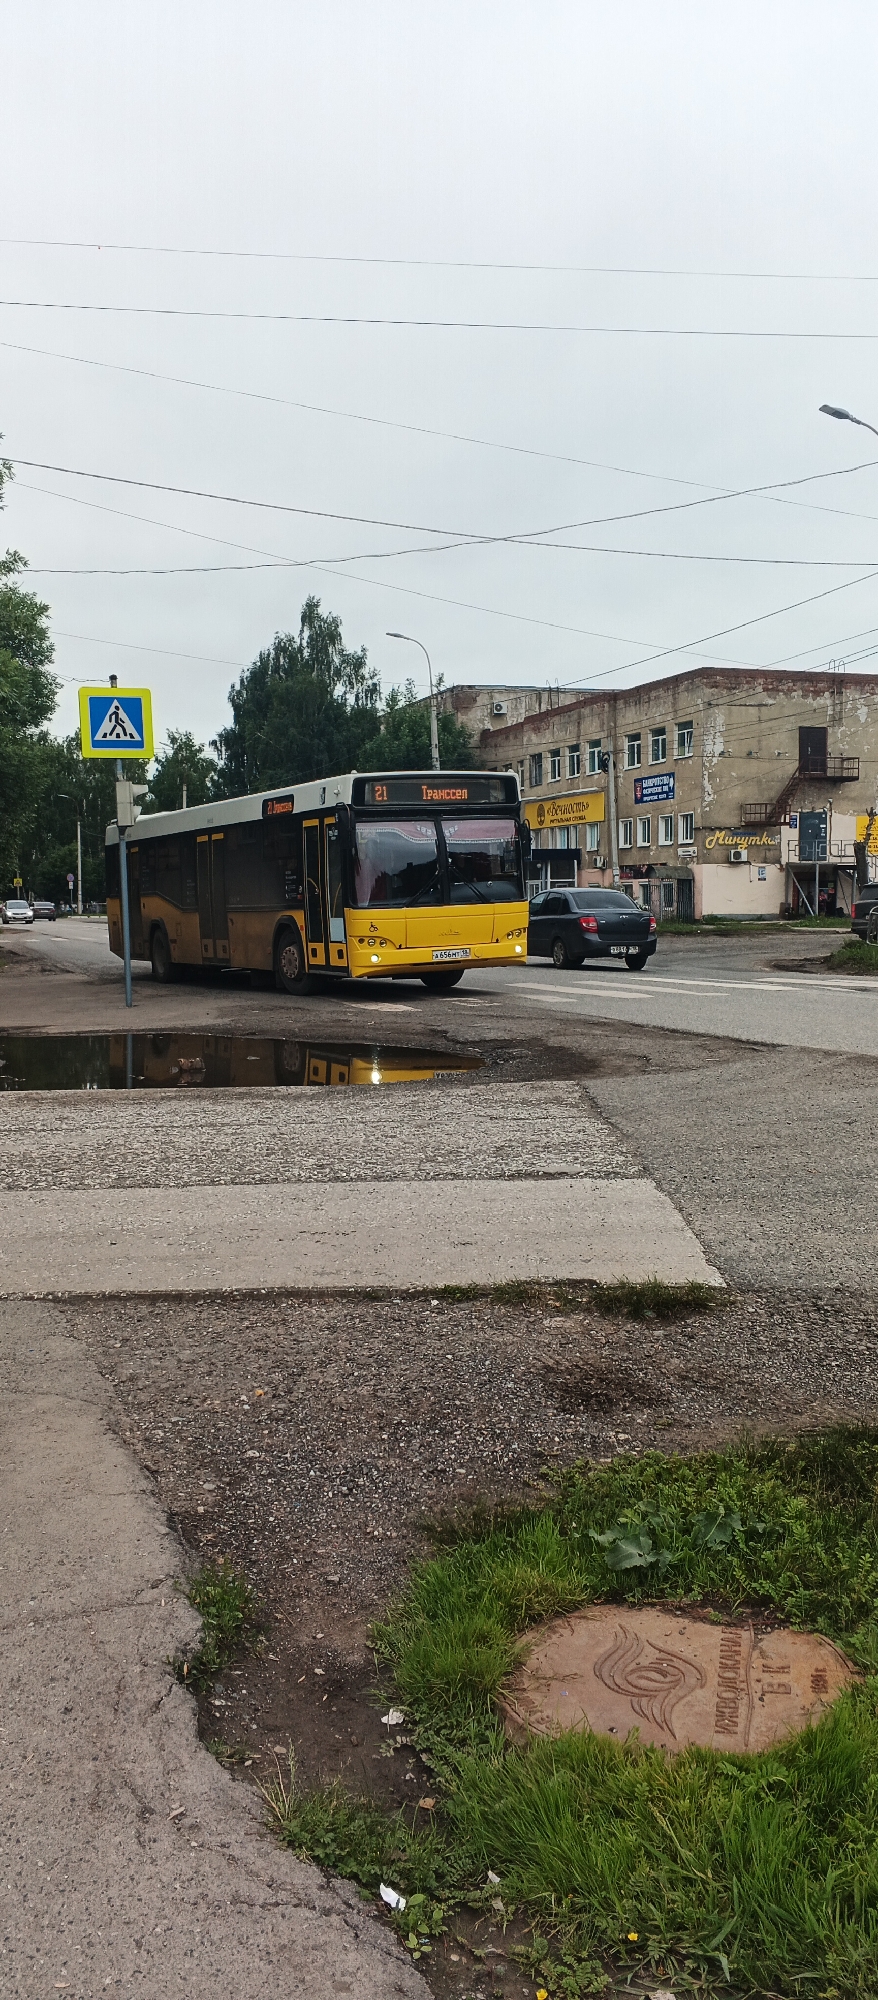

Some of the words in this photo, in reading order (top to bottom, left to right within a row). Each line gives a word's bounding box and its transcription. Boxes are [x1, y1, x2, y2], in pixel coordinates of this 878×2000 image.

[374, 785, 388, 800] 21
[421, 785, 468, 800] Транссел
[714, 1625, 745, 1735] ИЖВОДОКАНАЛ
